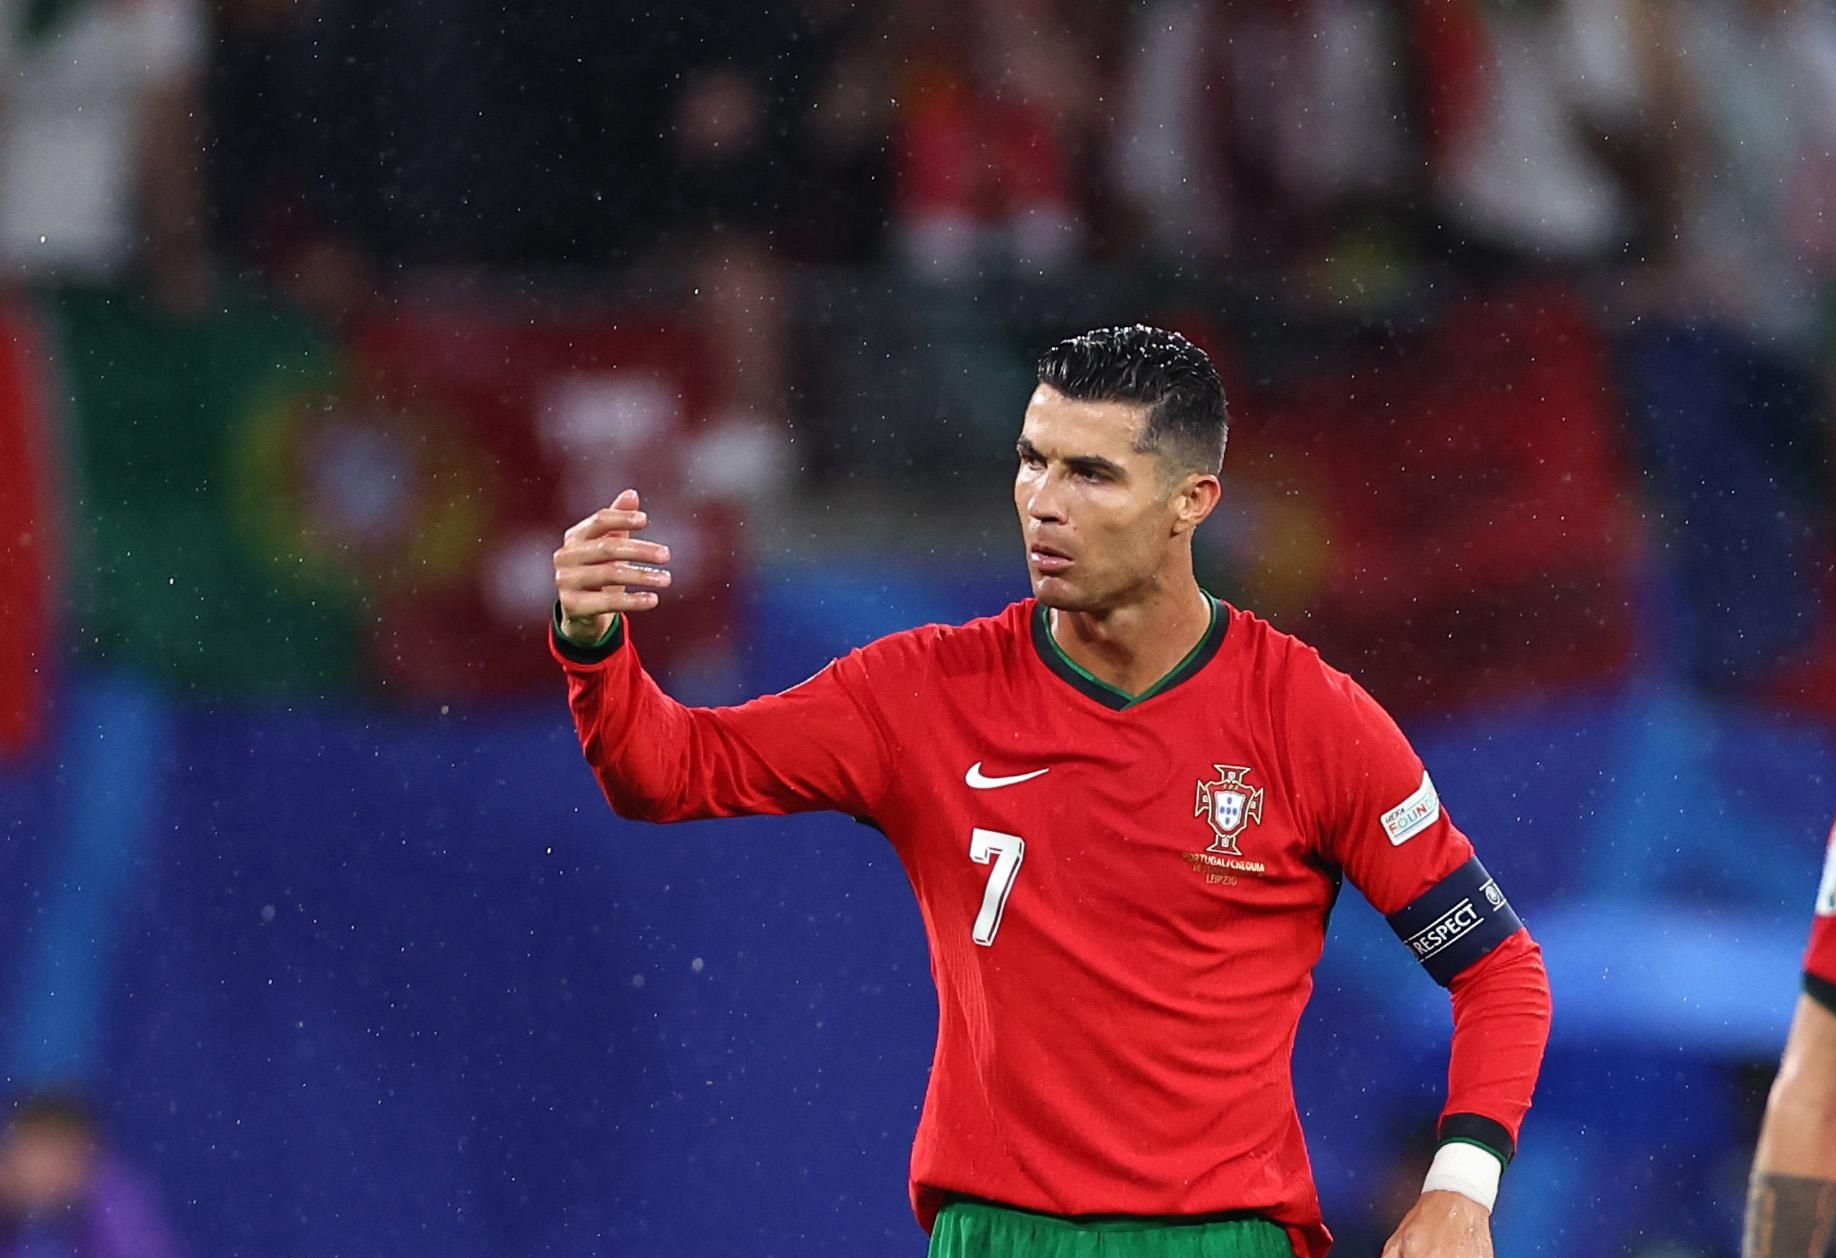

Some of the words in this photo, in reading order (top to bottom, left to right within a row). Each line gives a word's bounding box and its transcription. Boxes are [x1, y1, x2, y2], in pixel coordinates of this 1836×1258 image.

[969, 827, 1026, 947] 7
[1205, 873, 1238, 887] LEIPZIG
[1412, 903, 1477, 955] RESPECT
